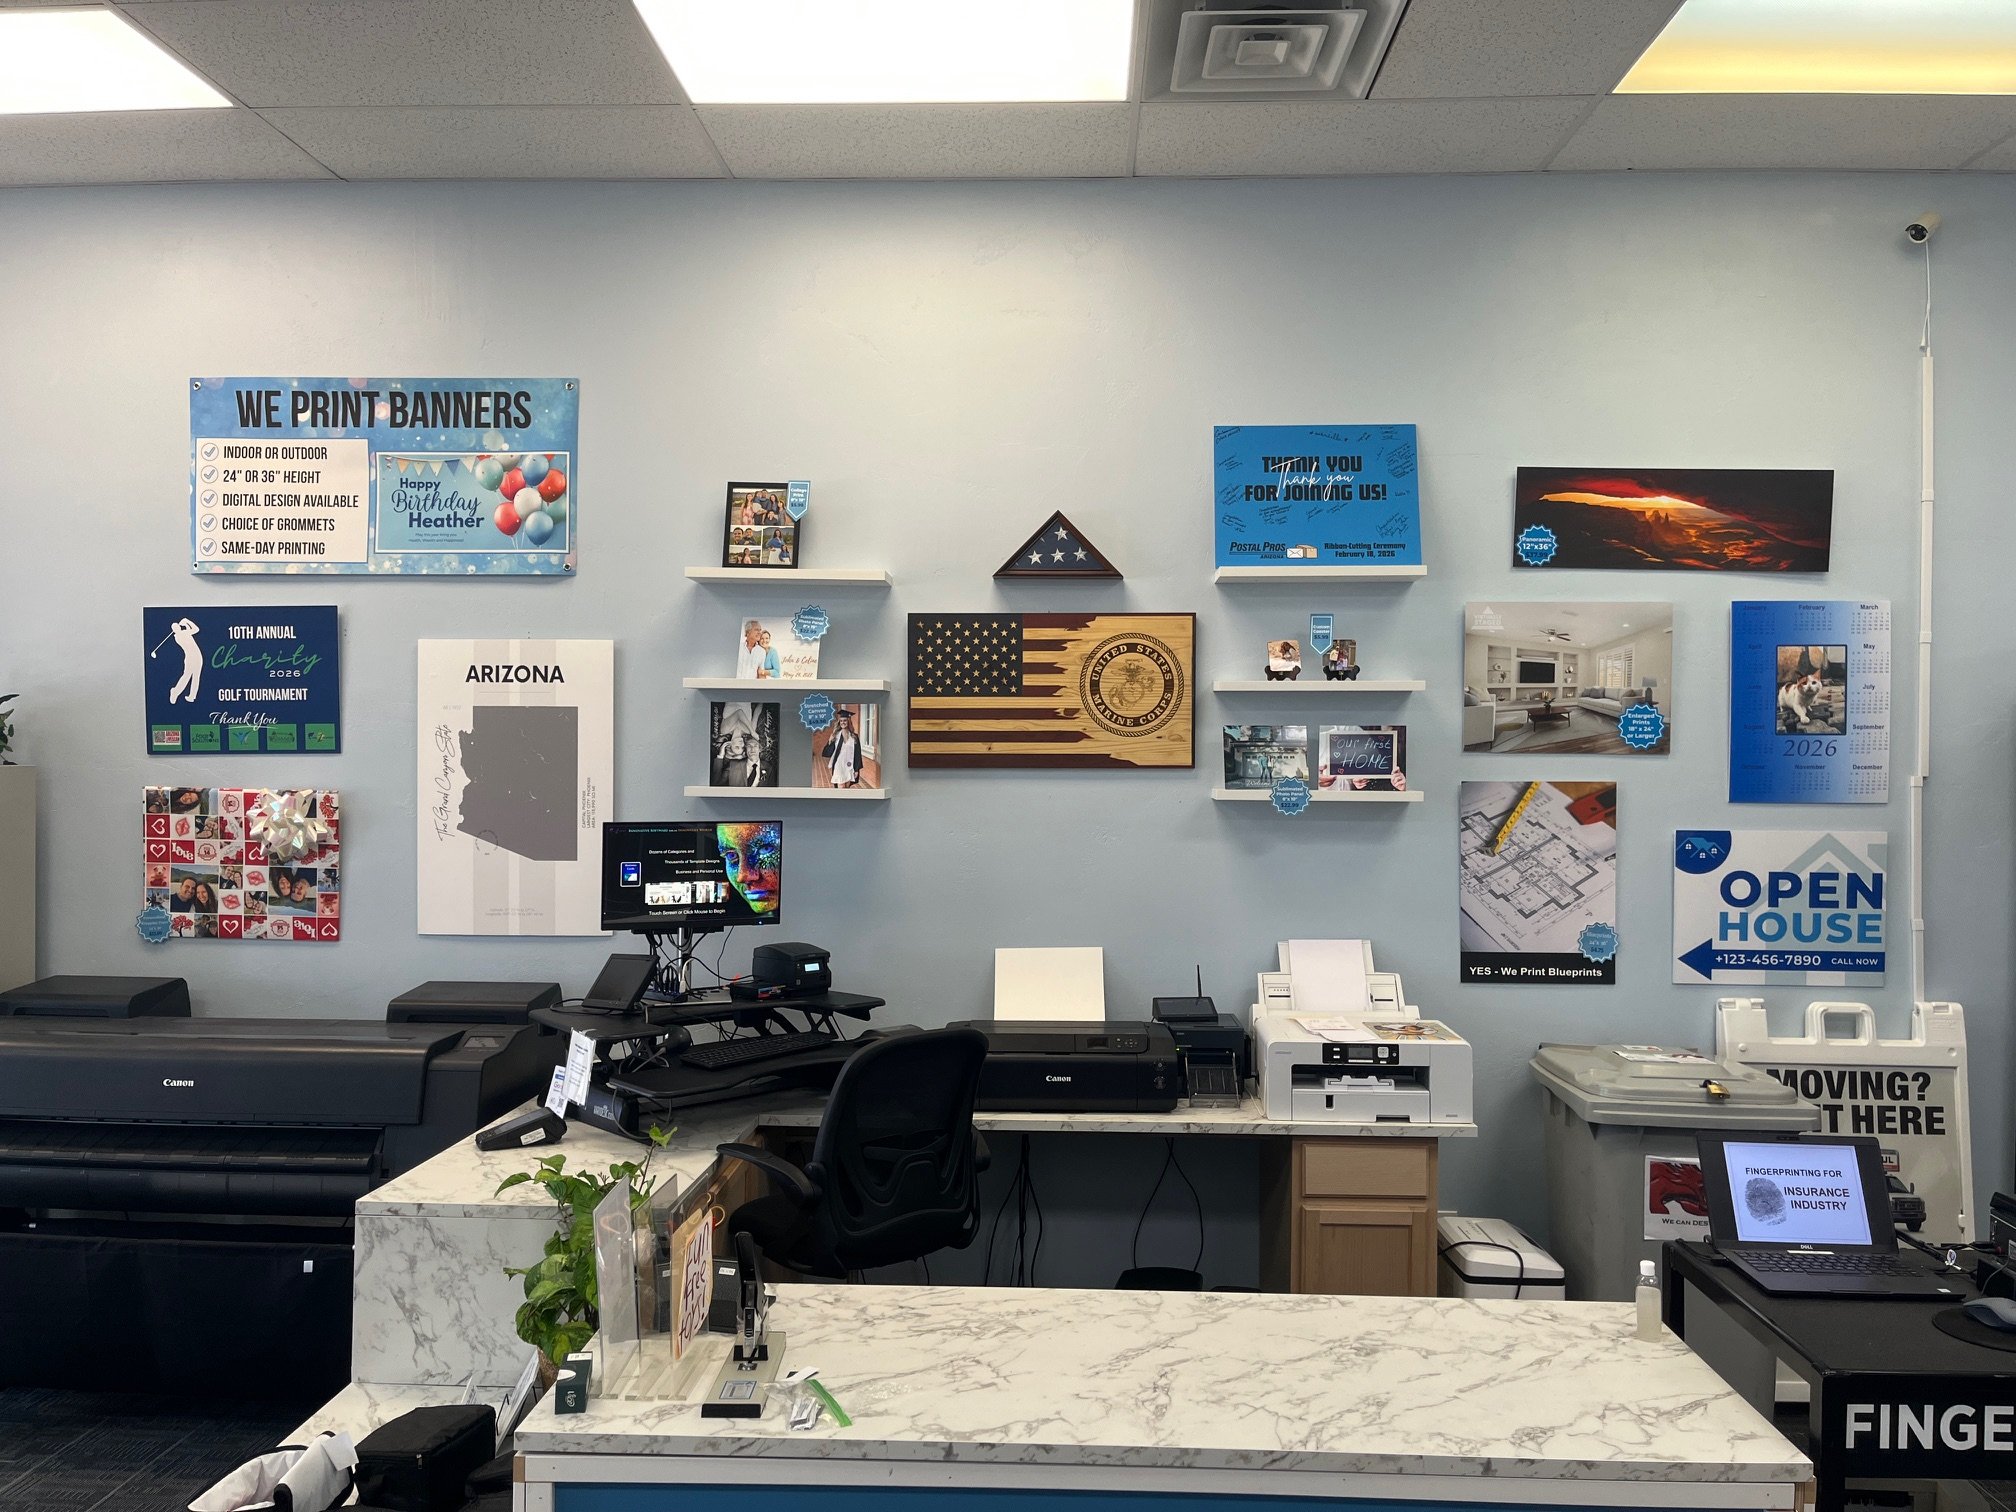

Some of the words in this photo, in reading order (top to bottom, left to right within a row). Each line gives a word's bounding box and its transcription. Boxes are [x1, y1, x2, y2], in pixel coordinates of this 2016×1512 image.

[235, 390, 283, 428] WE
[291, 390, 380, 429] PRINT
[389, 391, 532, 429] BANNERS
[223, 446, 262, 459] INDOOR
[264, 446, 279, 459] OR
[281, 447, 328, 460] OUTDOOR
[1262, 456, 1320, 472] THANK
[1326, 456, 1362, 472] YOU
[223, 469, 242, 482] 24"
[245, 470, 259, 483] OR
[261, 470, 281, 483] 36"
[283, 471, 321, 483] HEIGHT
[400, 478, 441, 491] Happy
[1270, 457, 1321, 498] Thank
[1323, 474, 1354, 501] you
[222, 494, 261, 507] DIGITAL
[264, 494, 300, 507] DESIGN
[303, 495, 359, 507] AVAILABLE
[1245, 485, 1279, 501] FOR
[1284, 484, 1352, 501] JOINING
[1359, 484, 1387, 500] US!
[391, 489, 482, 517] Birthday
[222, 517, 259, 530] CHOICE
[262, 518, 275, 530] OF
[277, 518, 335, 531] GROMMETS
[408, 511, 484, 528] Heather
[221, 541, 275, 554] SAME-DAY
[277, 542, 325, 555] PRINTING
[1230, 541, 1261, 551] POSTAL
[1263, 542, 1286, 551] PROS
[1373, 543, 1406, 551] Ceremony
[228, 626, 254, 640] 10TH
[256, 625, 297, 639] ANNUAL
[211, 644, 322, 674] Charity
[1091, 644, 1127, 681] UNITED
[1136, 644, 1172, 680] STATES
[269, 670, 301, 678] 2026
[465, 664, 565, 683] ARIZONA
[218, 688, 242, 701] GOLF
[244, 688, 308, 701] TOURNAMENT
[1092, 693, 1134, 726] MARINE
[1139, 692, 1172, 725] CORPS
[208, 711, 252, 725] Thank
[252, 711, 278, 731] You
[434, 724, 455, 757] State
[1364, 737, 1391, 750] first
[1783, 739, 1838, 757] 2026
[1341, 753, 1391, 770] HOME
[434, 755, 455, 791] Canyon
[432, 791, 451, 821] Grand
[433, 819, 455, 842] The
[1720, 870, 1884, 909] OPEN
[1719, 911, 1883, 943] HOUSE
[1715, 954, 1821, 966] +123-456-7890
[1831, 957, 1853, 965] CALL
[1856, 957, 1878, 966] NOW
[1469, 967, 1491, 975] YES
[1500, 967, 1517, 975] We
[1520, 967, 1545, 976] Print
[1548, 968, 1602, 978] Blueprints
[162, 1078, 194, 1087] Canon
[1852, 1105, 1946, 1135] HERE
[1745, 1167, 1821, 1177] FINGERPRINTING
[1823, 1169, 1842, 1178] FOR
[1784, 1186, 1850, 1198] INSURANCE
[1791, 1200, 1847, 1210] INDUSTRY
[1845, 1403, 2015, 1451] FINGE
